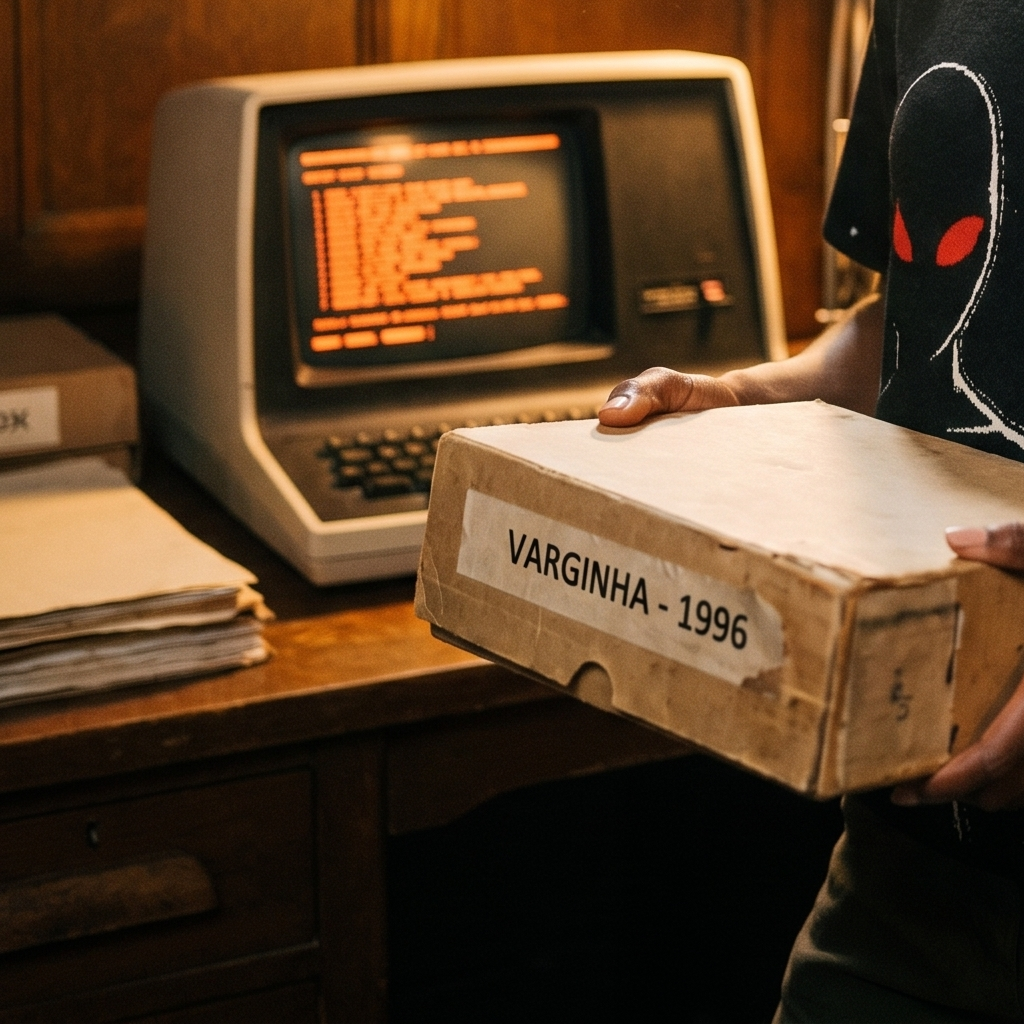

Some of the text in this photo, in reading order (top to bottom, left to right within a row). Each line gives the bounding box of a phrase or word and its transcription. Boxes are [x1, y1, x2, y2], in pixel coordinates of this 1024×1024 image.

[508, 529, 748, 650] VARGINHA - 1996
